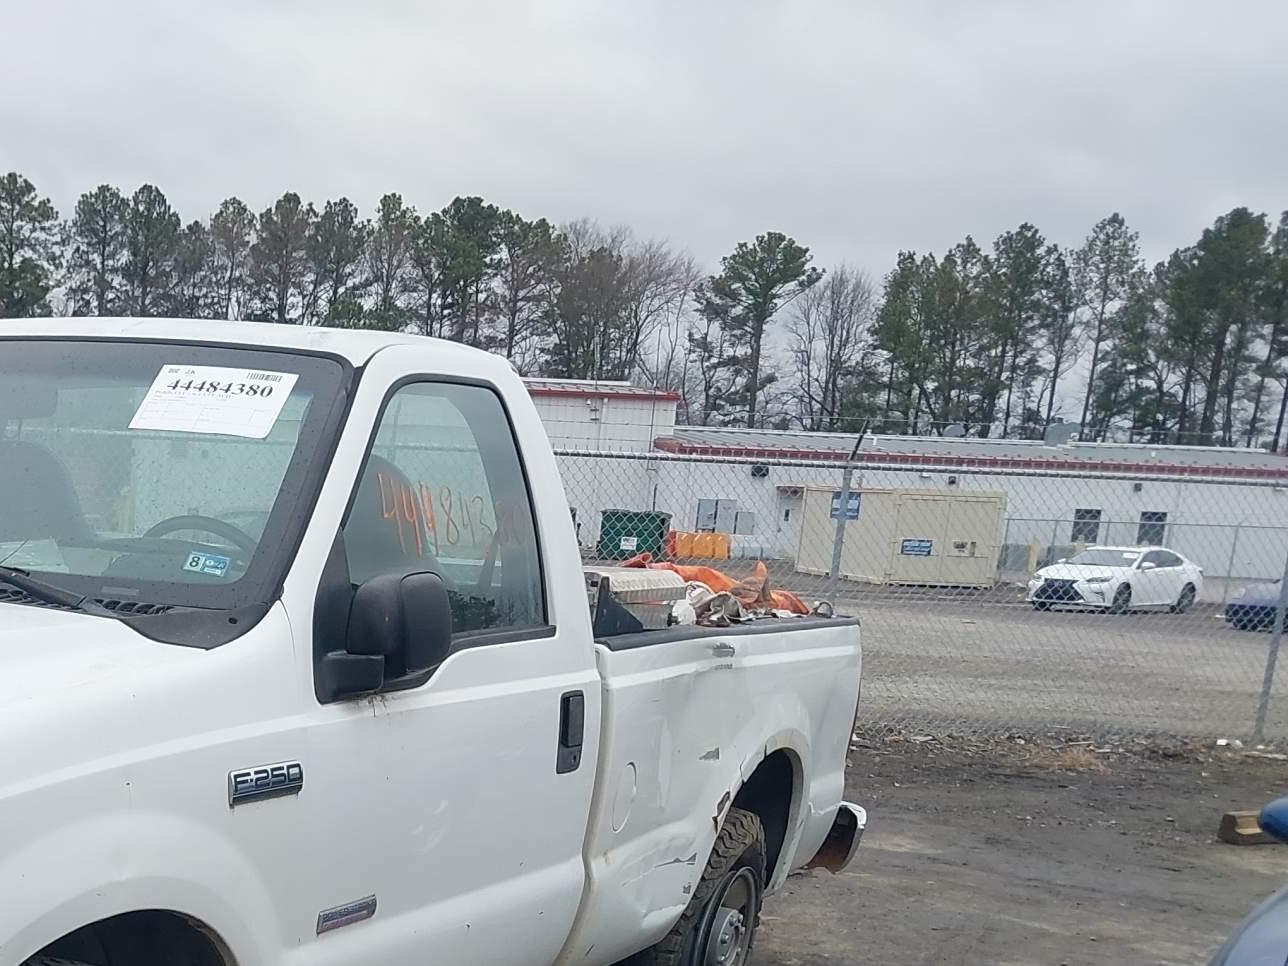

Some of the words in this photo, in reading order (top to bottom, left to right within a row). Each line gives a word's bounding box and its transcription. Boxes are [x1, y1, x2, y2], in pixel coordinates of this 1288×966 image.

[167, 378, 274, 398] 44484380
[189, 556, 201, 568] 8
[233, 763, 302, 793] F-250
